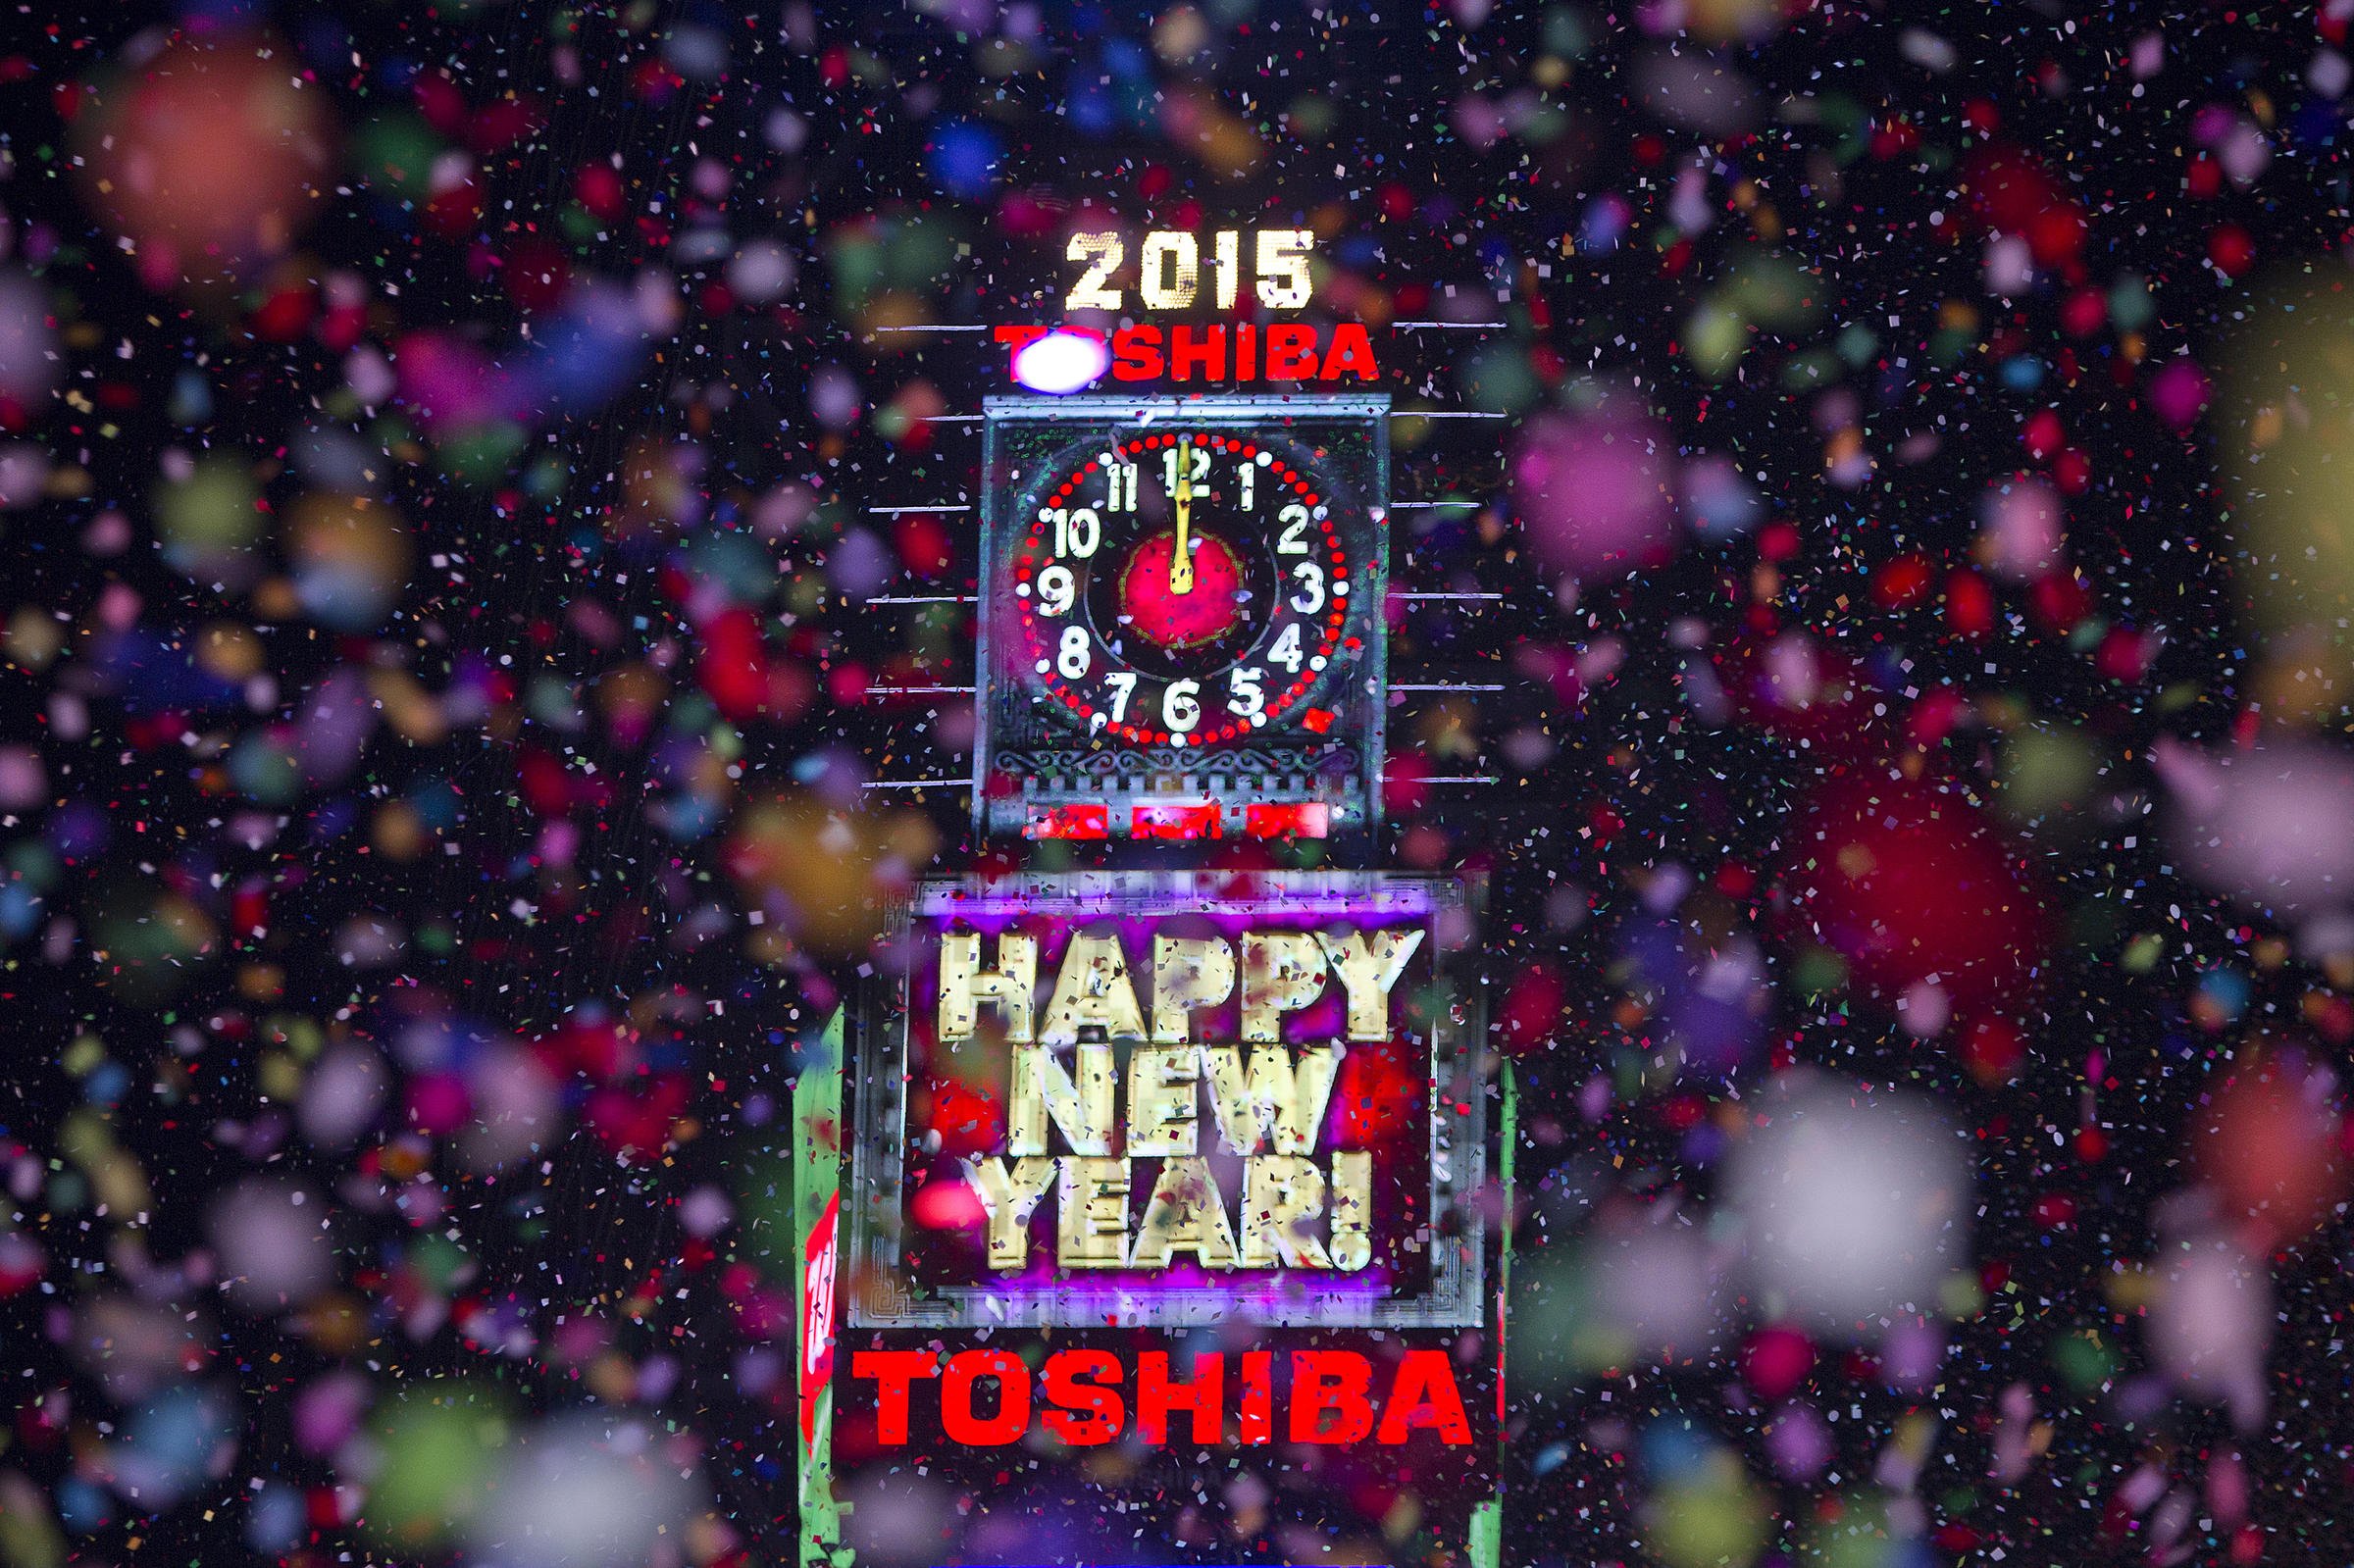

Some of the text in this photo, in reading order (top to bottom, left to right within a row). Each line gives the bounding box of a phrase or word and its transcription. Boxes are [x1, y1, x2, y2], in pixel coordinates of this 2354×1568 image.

[1065, 229, 1314, 311] 2015
[1106, 462, 1138, 513] 11
[1162, 448, 1211, 497] 12
[1238, 462, 1254, 512] 1
[1052, 508, 1100, 559] 10
[1277, 504, 1308, 554] 2
[1037, 565, 1075, 617] 9
[1290, 562, 1325, 614] 3
[1056, 625, 1091, 680] 8
[1267, 623, 1304, 673] 4
[1103, 672, 1137, 723] 7
[1162, 680, 1201, 733] 6
[1227, 668, 1265, 717] 5
[939, 929, 1425, 1044] HAPPY
[1007, 1041, 1345, 1157] NEW
[962, 1150, 1373, 1272] YEAR!
[852, 1349, 1474, 1446] TOSHIBA
